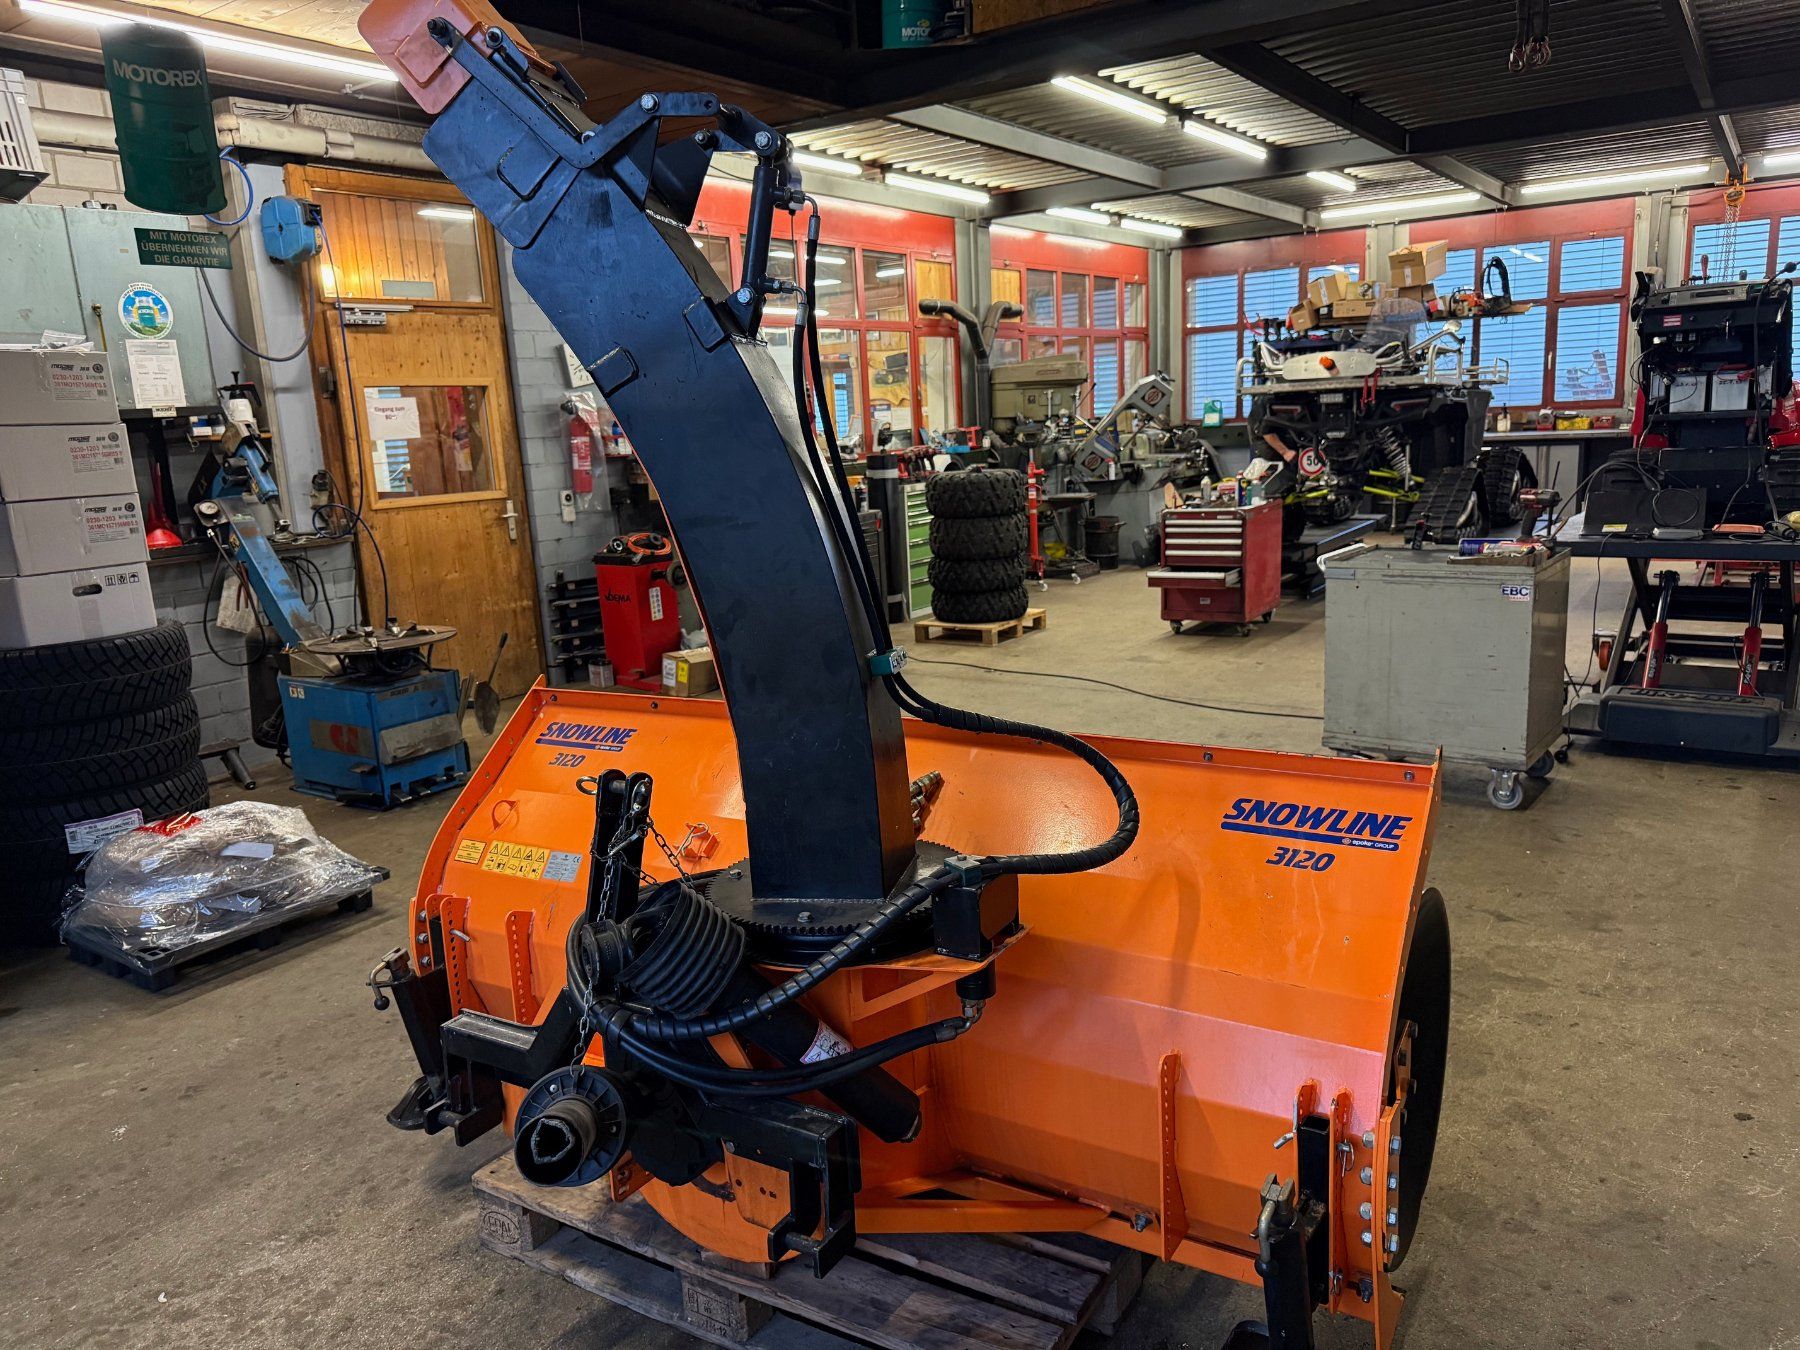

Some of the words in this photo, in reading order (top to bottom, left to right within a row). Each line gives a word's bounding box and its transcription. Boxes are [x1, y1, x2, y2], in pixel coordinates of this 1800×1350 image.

[112, 58, 203, 88] MOTOREX
[150, 231, 168, 241] MIT
[170, 233, 217, 244] MOTOREX
[140, 240, 210, 255] ÜBERNEHMEN
[210, 247, 228, 256] WIR
[155, 254, 171, 264] DIE
[172, 255, 220, 266] GARANTIE
[1502, 586, 1529, 597] EBC
[539, 721, 638, 745] SNOWLINE
[548, 752, 586, 768] 3120
[1222, 797, 1413, 840] SNOWLINE
[1265, 846, 1336, 872] 3120
